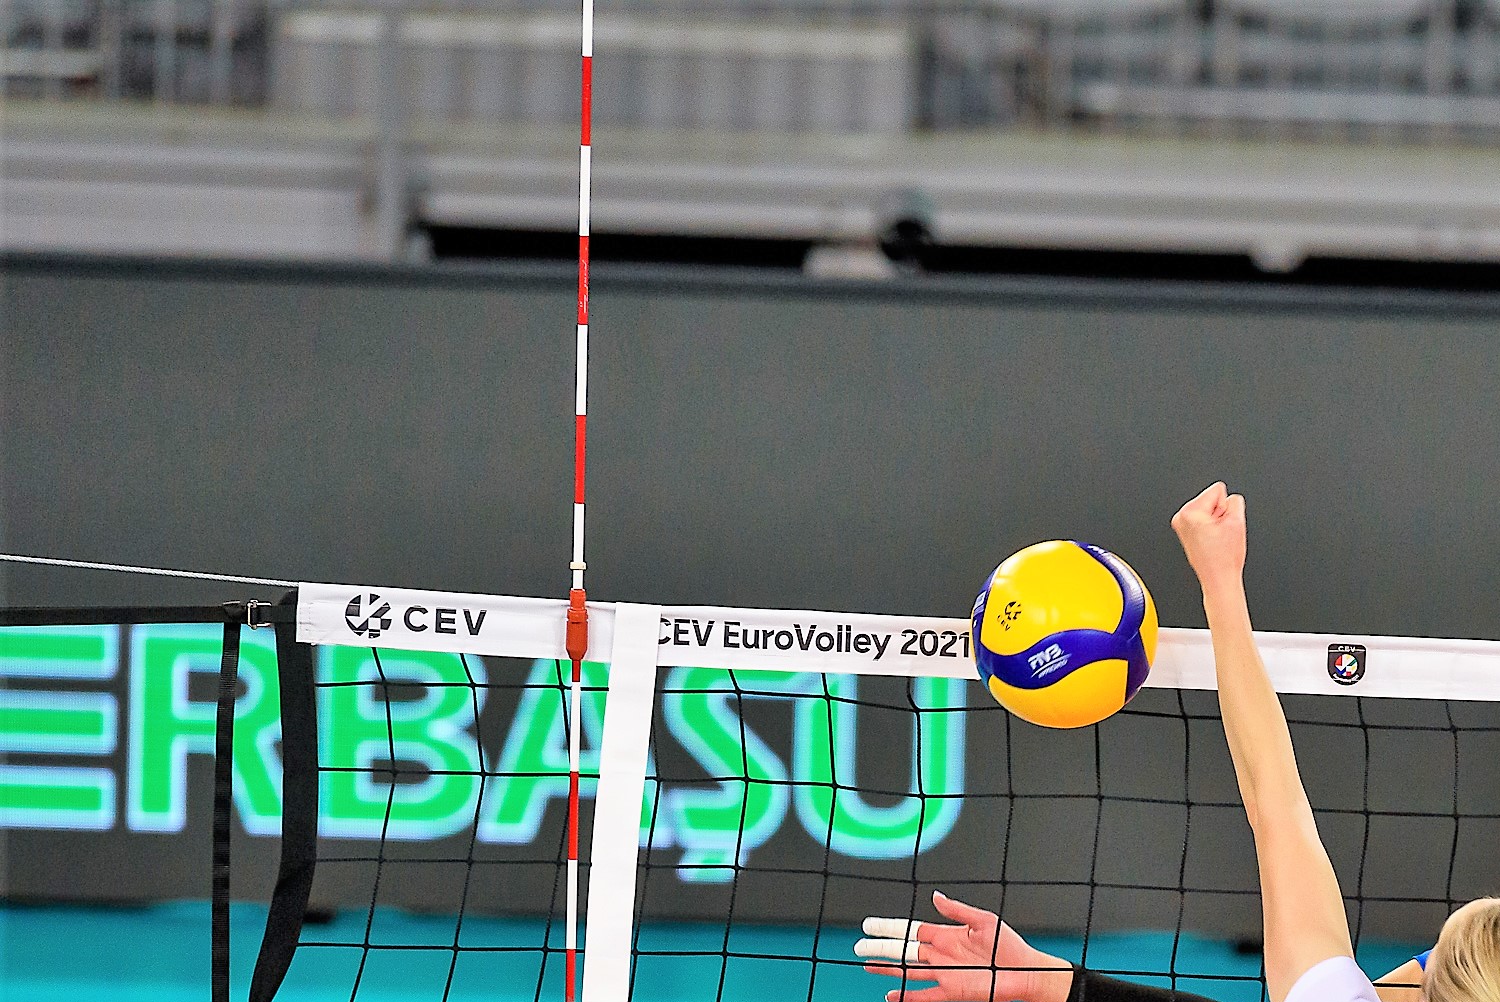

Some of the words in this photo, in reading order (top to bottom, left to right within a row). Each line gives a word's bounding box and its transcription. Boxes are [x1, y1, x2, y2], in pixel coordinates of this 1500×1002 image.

[403, 605, 488, 636] CEV
[724, 621, 891, 662] EuroVolley
[900, 629, 969, 658] 2021
